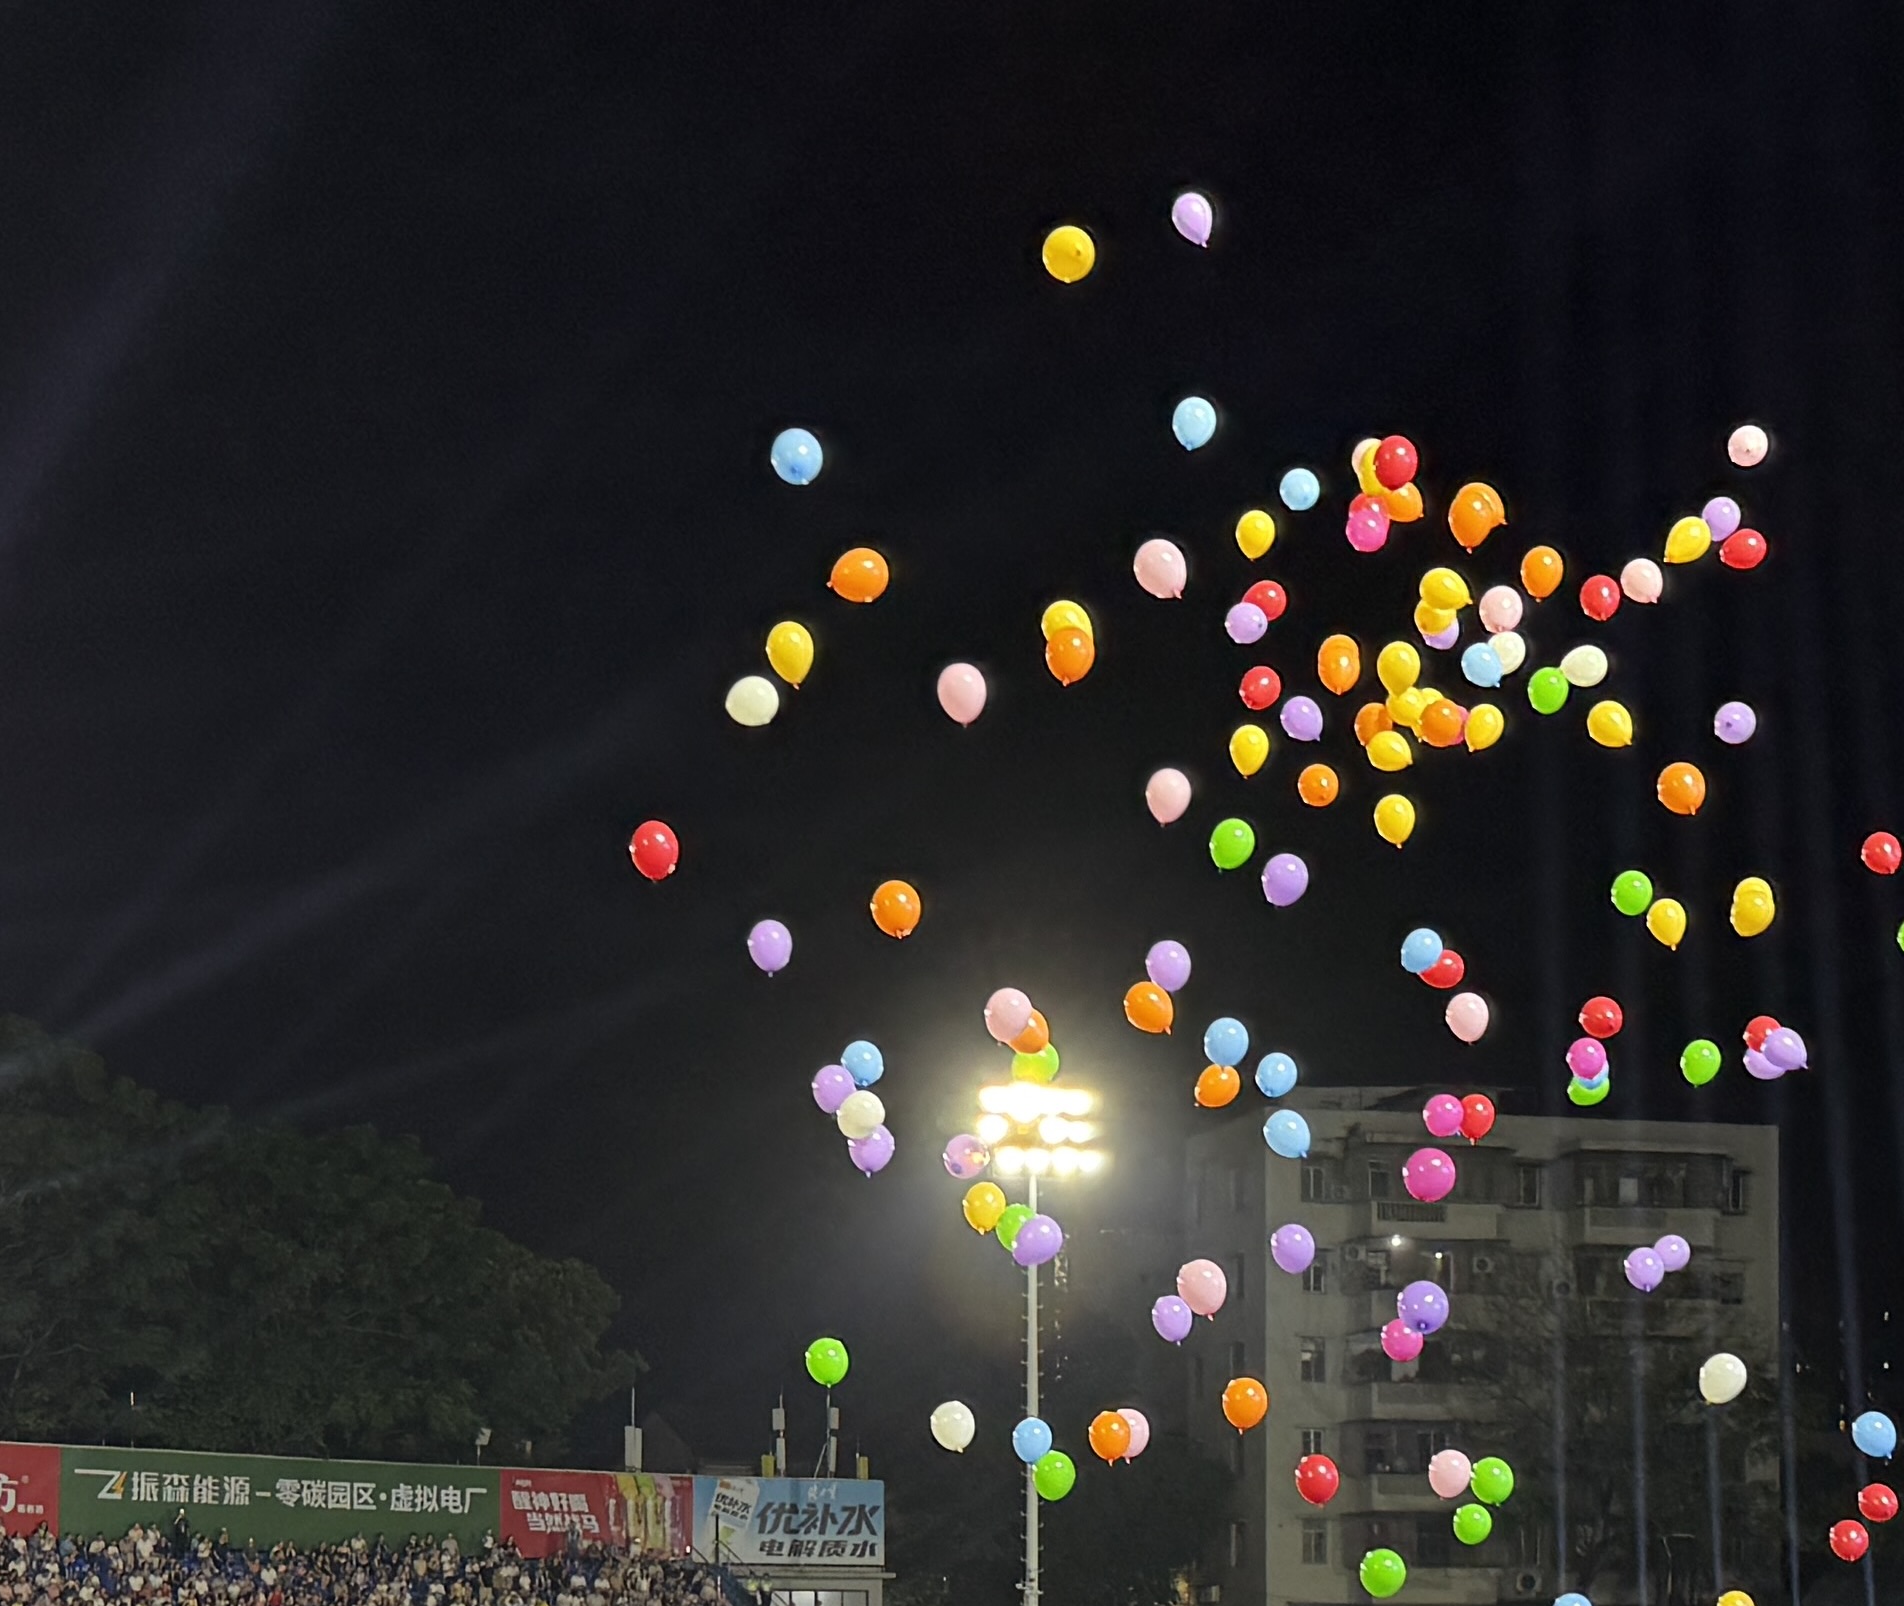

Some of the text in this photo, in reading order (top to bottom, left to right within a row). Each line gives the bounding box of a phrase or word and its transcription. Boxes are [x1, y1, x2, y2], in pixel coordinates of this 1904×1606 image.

[756, 1502, 881, 1536] 优补水
[759, 1539, 879, 1558] 电解质水
